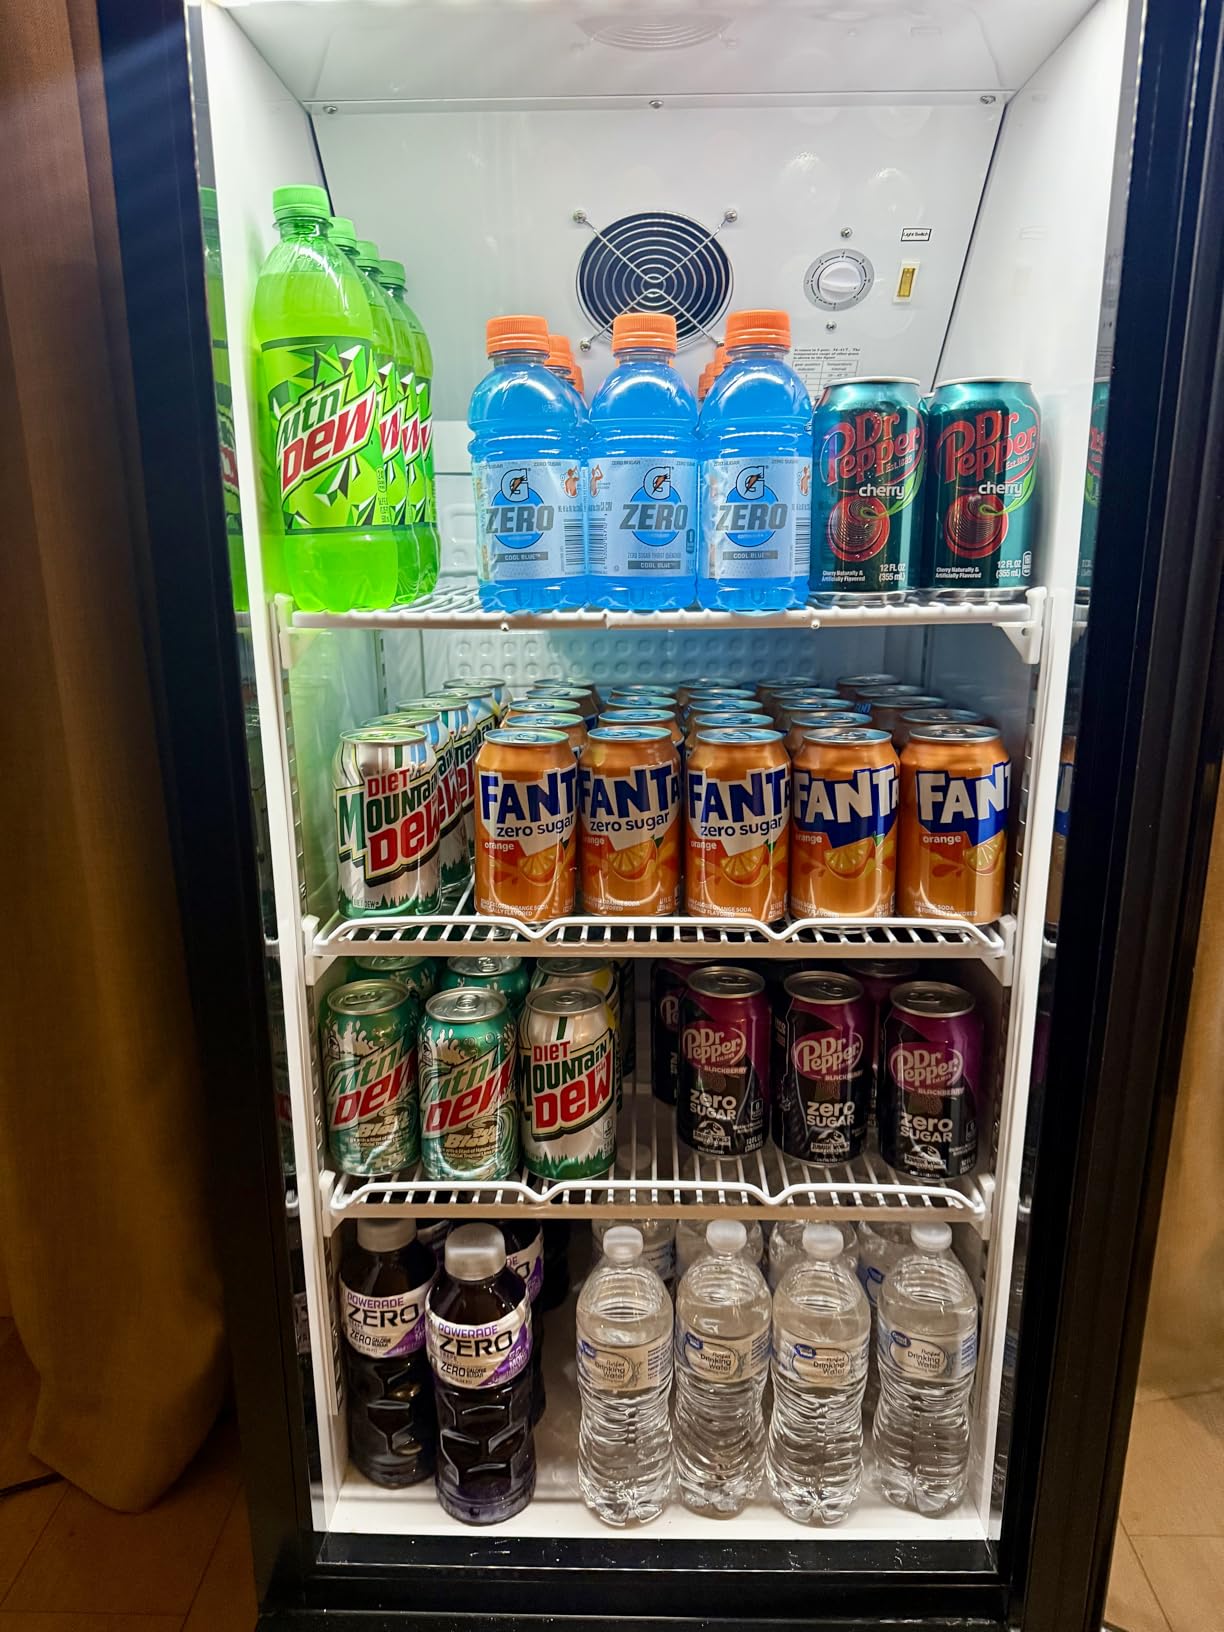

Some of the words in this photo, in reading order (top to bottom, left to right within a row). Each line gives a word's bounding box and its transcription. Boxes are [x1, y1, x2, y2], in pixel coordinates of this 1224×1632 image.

[855, 411, 900, 450] Dr
[975, 411, 1020, 450] Dr
[821, 422, 920, 487] Pepper
[936, 421, 1037, 484] Pepper
[858, 483, 905, 500] cherry
[978, 481, 1023, 500] cherry
[485, 505, 555, 534] ZERO
[619, 504, 689, 531] ZERO
[715, 503, 788, 531] ZERO
[880, 564, 889, 572] 12
[898, 563, 906, 571] OZ
[951, 566, 975, 574] Naturally
[995, 569, 1010, 579] (355
[997, 561, 1005, 569] 12
[879, 572, 894, 582] (355
[496, 825, 533, 838] zero
[536, 813, 575, 835] sugar
[590, 819, 622, 832] zero
[626, 811, 670, 831] sugar
[701, 823, 736, 837] zero
[739, 815, 783, 836] sugar
[484, 841, 515, 852] orange
[691, 840, 717, 851] orange
[922, 834, 962, 845] orange
[937, 903, 955, 911] SODA
[683, 1028, 741, 1064] Pepper
[700, 1028, 725, 1047] Dr
[533, 1040, 571, 1063] DIET
[820, 1037, 847, 1057] Dr
[796, 1040, 860, 1074] Pepper
[913, 1049, 942, 1069] Dr
[704, 1065, 748, 1075] BLACKBERRY
[891, 1049, 958, 1086] Pepper
[690, 1089, 737, 1110] zero
[690, 1102, 737, 1120] SUGAR
[807, 1101, 856, 1117] zero
[806, 1114, 855, 1127] SUGAR
[900, 1112, 953, 1132] zero
[900, 1125, 953, 1143] SUGAR
[347, 1291, 405, 1310] POWERADE
[347, 1302, 420, 1328] ZERO
[350, 1329, 372, 1347] ZERO
[438, 1323, 499, 1339] POWERADE
[439, 1330, 513, 1358] ZERO
[700, 1353, 731, 1366] Drinking
[813, 1360, 845, 1369] Drinking
[907, 1350, 941, 1365] Drinking
[916, 1359, 941, 1369] Water
[440, 1361, 466, 1378] ZERO
[594, 1361, 625, 1374] Drinking
[603, 1371, 625, 1380] Water
[708, 1363, 732, 1371] Water
[822, 1368, 845, 1376] Water
